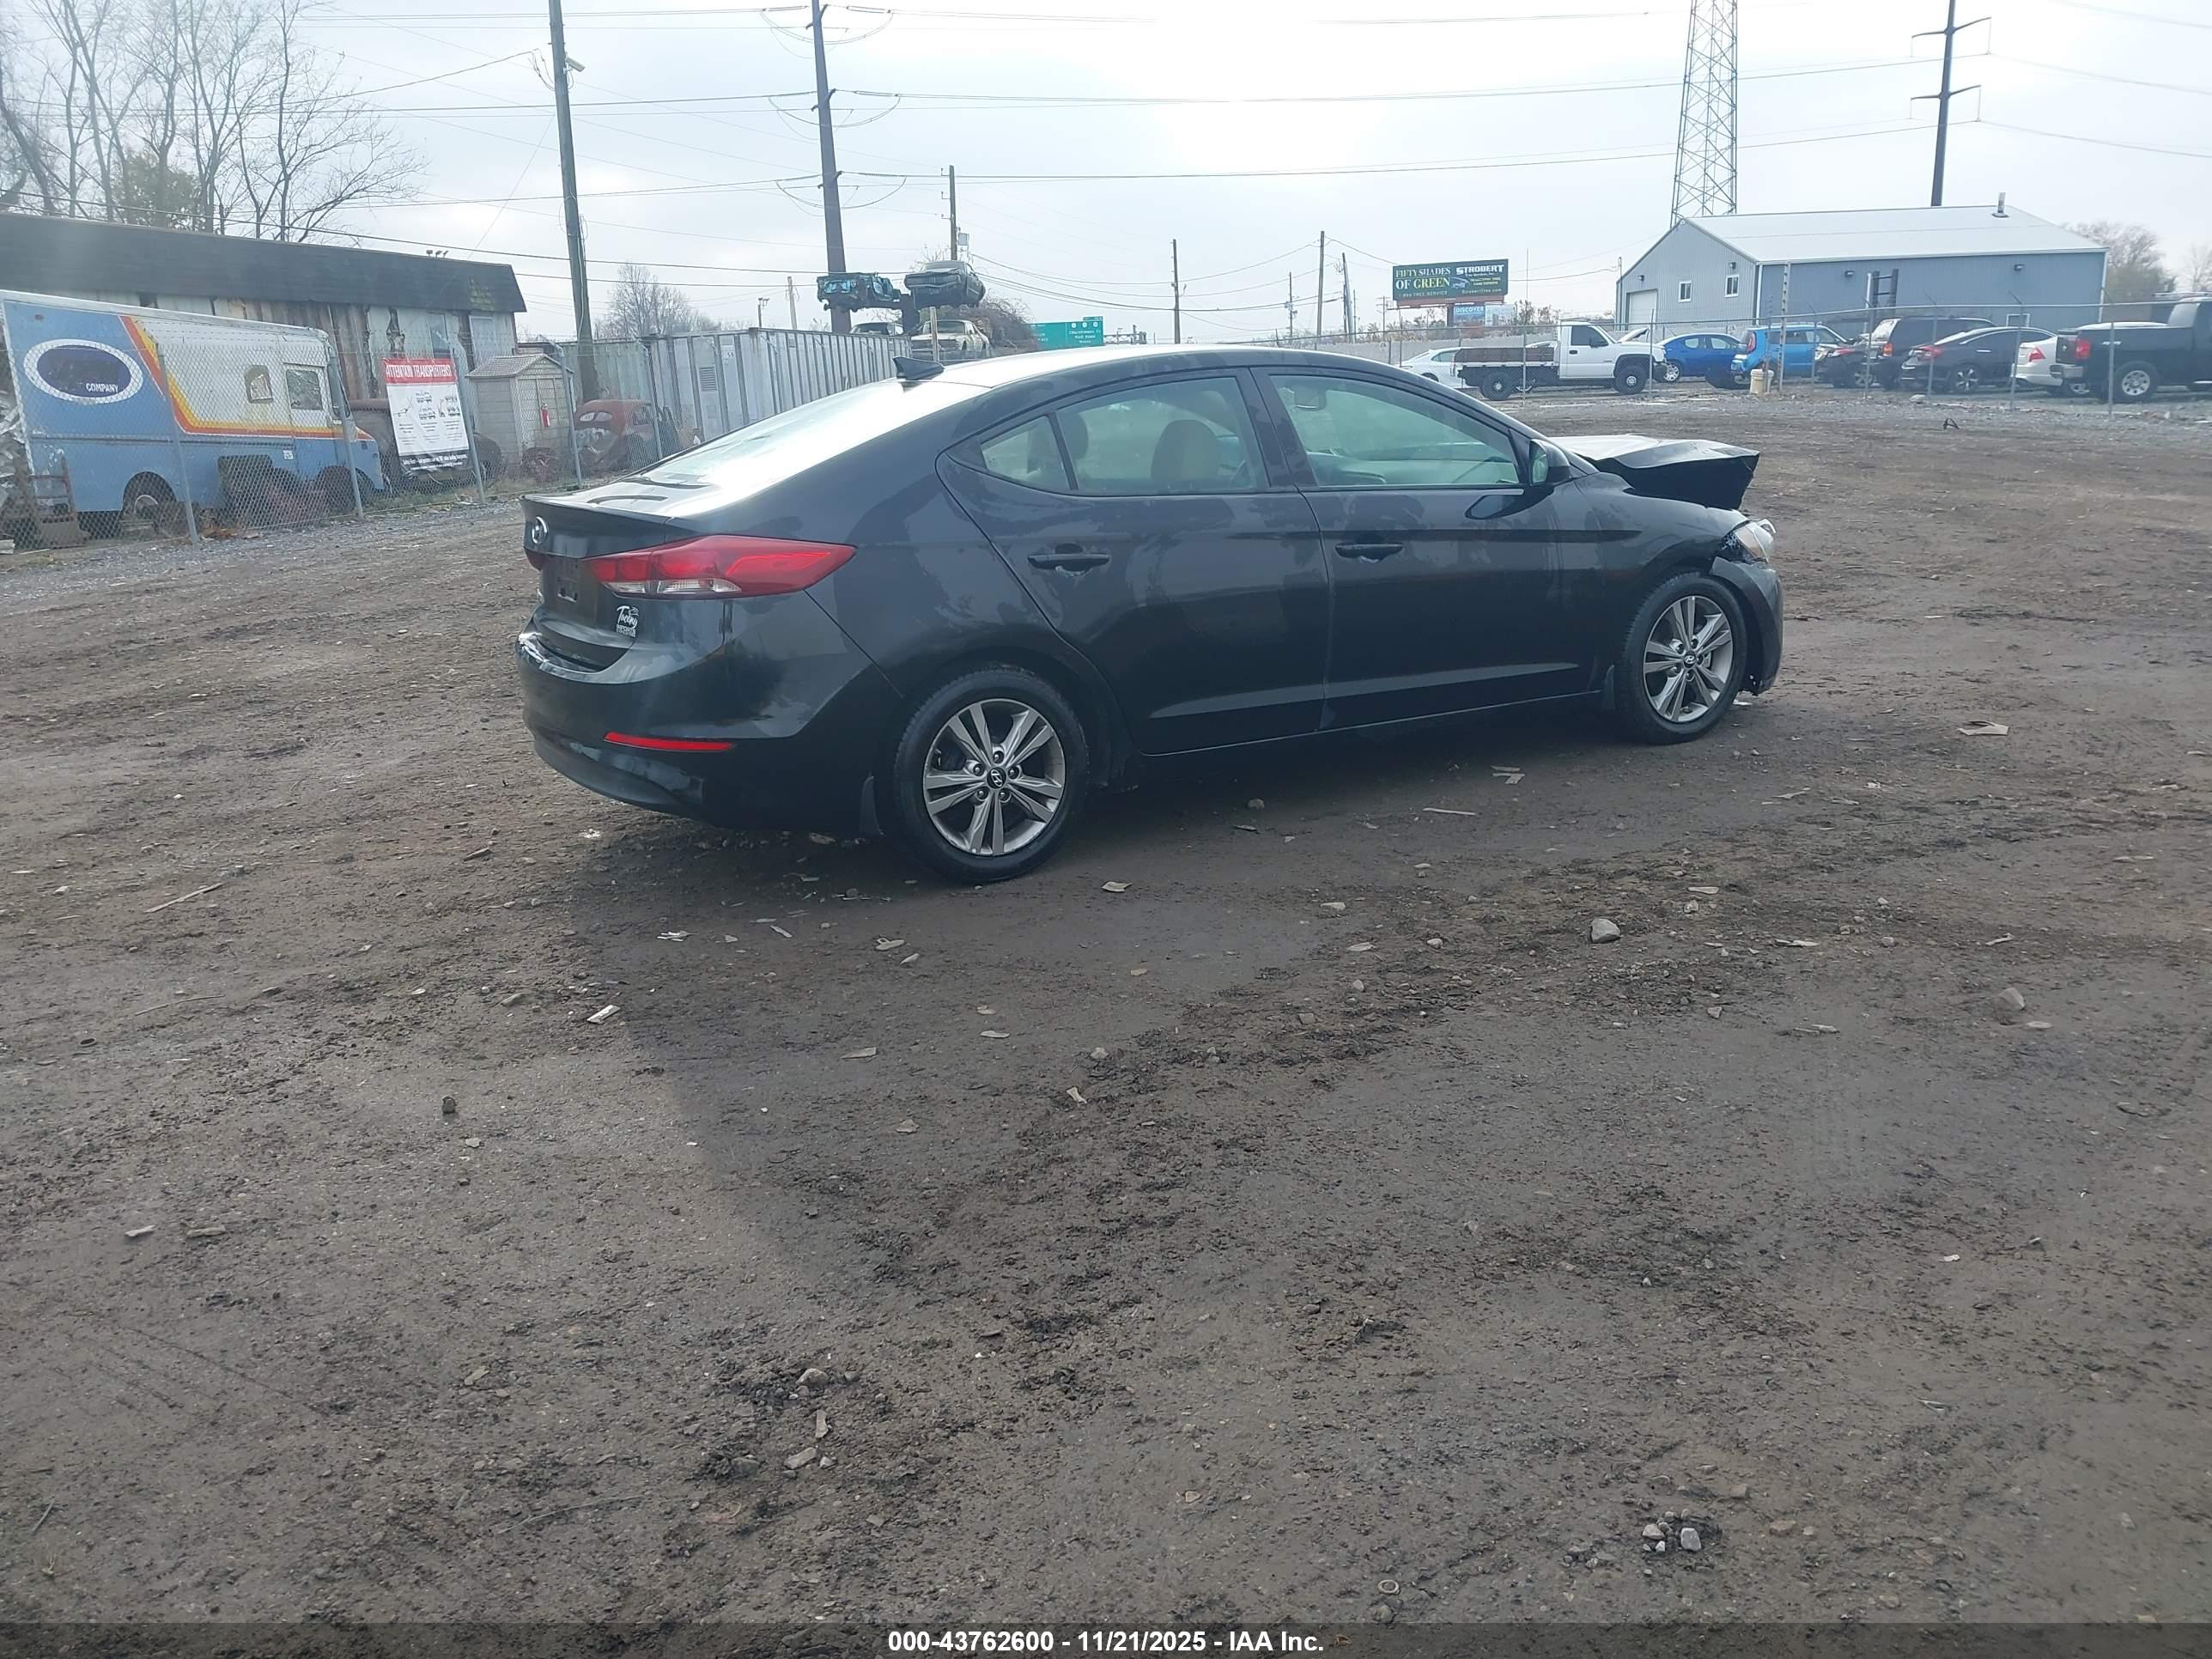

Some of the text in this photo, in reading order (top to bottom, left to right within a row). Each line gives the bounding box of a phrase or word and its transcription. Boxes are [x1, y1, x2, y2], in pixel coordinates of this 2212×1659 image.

[1395, 267, 1451, 278] FIFTY SHADES
[1395, 276, 1450, 290] OF GREEN
[386, 365, 413, 378] ATTENTION
[85, 382, 118, 393] COMPANY
